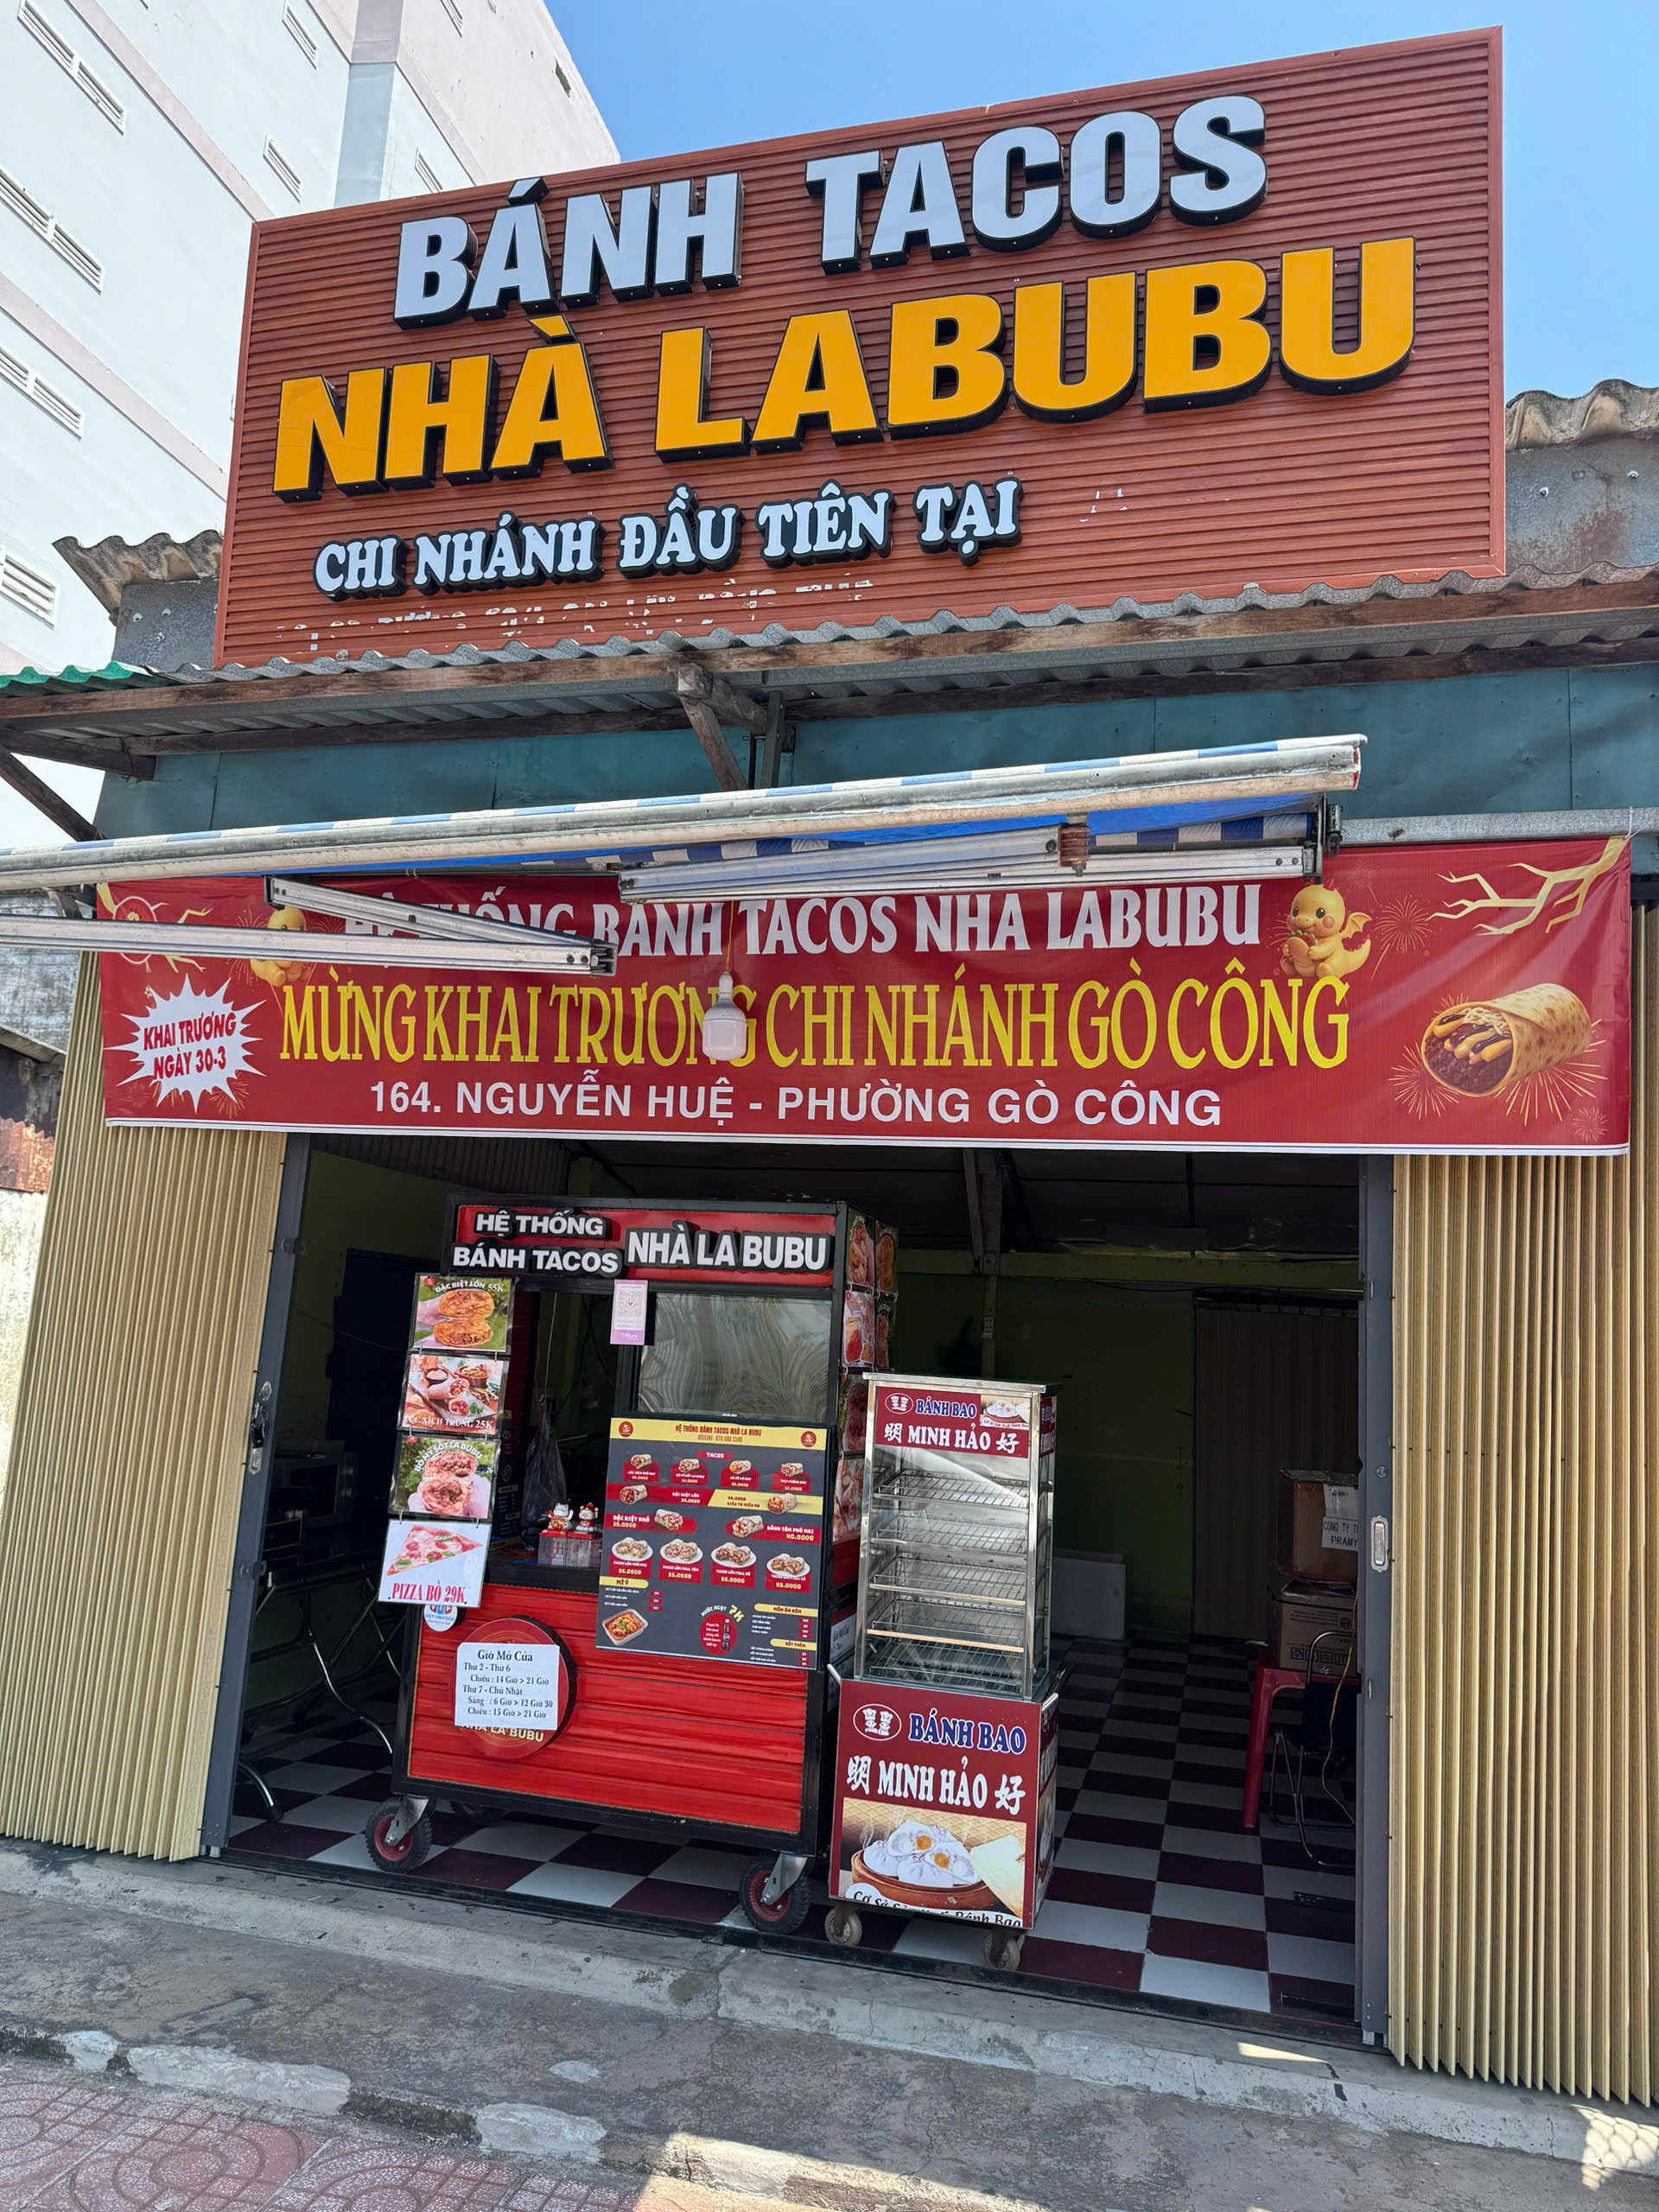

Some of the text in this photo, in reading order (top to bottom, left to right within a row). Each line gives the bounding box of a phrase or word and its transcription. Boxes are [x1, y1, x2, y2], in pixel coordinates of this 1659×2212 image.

[394, 94, 1267, 328] BÁNH TACOS
[272, 314, 613, 503] NHÀ
[313, 477, 1024, 601] CHI NHÁNH ĐẦU TIÊN TẠI
[738, 896, 897, 955] TACOS
[1046, 884, 1261, 951] LABUBU
[280, 967, 416, 1063] MỪNG
[423, 984, 539, 1064] KHAI
[766, 983, 855, 1068] CHI
[865, 961, 1058, 1067] NHÁNH
[1068, 957, 1157, 1070] GÒ
[1167, 957, 1351, 1069] CÔNG
[143, 1011, 237, 1051] KHAI TRƯƠNG
[153, 1046, 226, 1080] NGÀY 30-3
[371, 1081, 442, 1115] 164.
[457, 1069, 632, 1118] NGUYỄN
[648, 1077, 734, 1126] HUỆ
[779, 1077, 969, 1124] PHƯỜNG
[988, 1080, 1058, 1124] GÒ
[1076, 1081, 1221, 1127] CÔNG
[475, 1210, 604, 1236] HỆ THỐNG
[453, 1245, 620, 1274] BÁNH TACOS
[628, 1224, 827, 1270] NHÀ LA BUBU
[487, 1283, 505, 1293] 55K
[915, 1395, 977, 1420] BÁNH BAO
[475, 1420, 494, 1430] 25K
[907, 1425, 951, 1448] MINH
[954, 1422, 991, 1451] HẢO
[995, 1432, 1020, 1454] 好
[460, 1443, 483, 1459] BUBU
[1331, 1535, 1358, 1548] PRAMY
[1343, 1522, 1350, 1534] TY
[391, 1580, 466, 1604] PIZZA BÒ 29K
[477, 1649, 493, 1661] Giờ
[514, 1650, 533, 1662] Cửa
[526, 1676, 534, 1685] 21
[509, 1727, 544, 1742] BUBU
[908, 1707, 974, 1748] BÁNH
[977, 1720, 1027, 1755] BAO
[877, 1760, 935, 1802] MINH
[939, 1756, 988, 1808] HẢO
[995, 1774, 1026, 1815] 好
